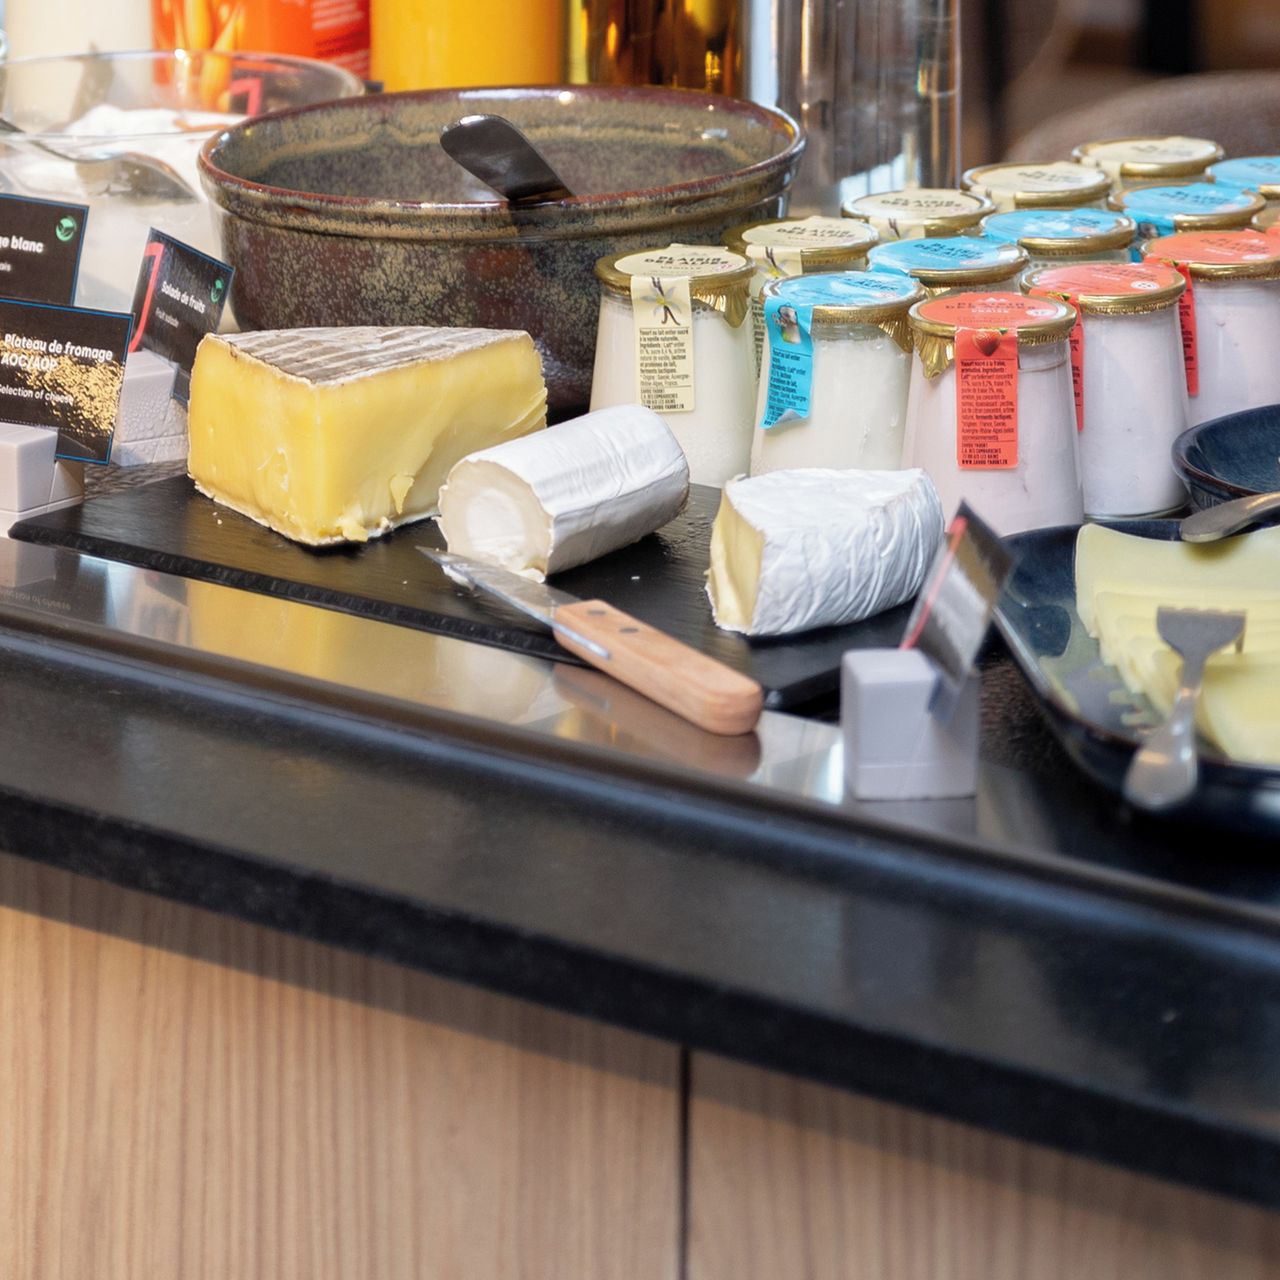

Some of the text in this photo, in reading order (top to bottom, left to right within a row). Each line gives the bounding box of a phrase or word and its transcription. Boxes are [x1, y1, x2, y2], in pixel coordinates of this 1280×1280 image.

[792, 226, 851, 235] PLAISIR
[11, 235, 44, 253] blanc
[161, 280, 206, 314] Salade de fruits
[4, 333, 113, 362] Plateau de fromage
[1, 353, 58, 370] AOC/AOP
[34, 390, 44, 399] of
